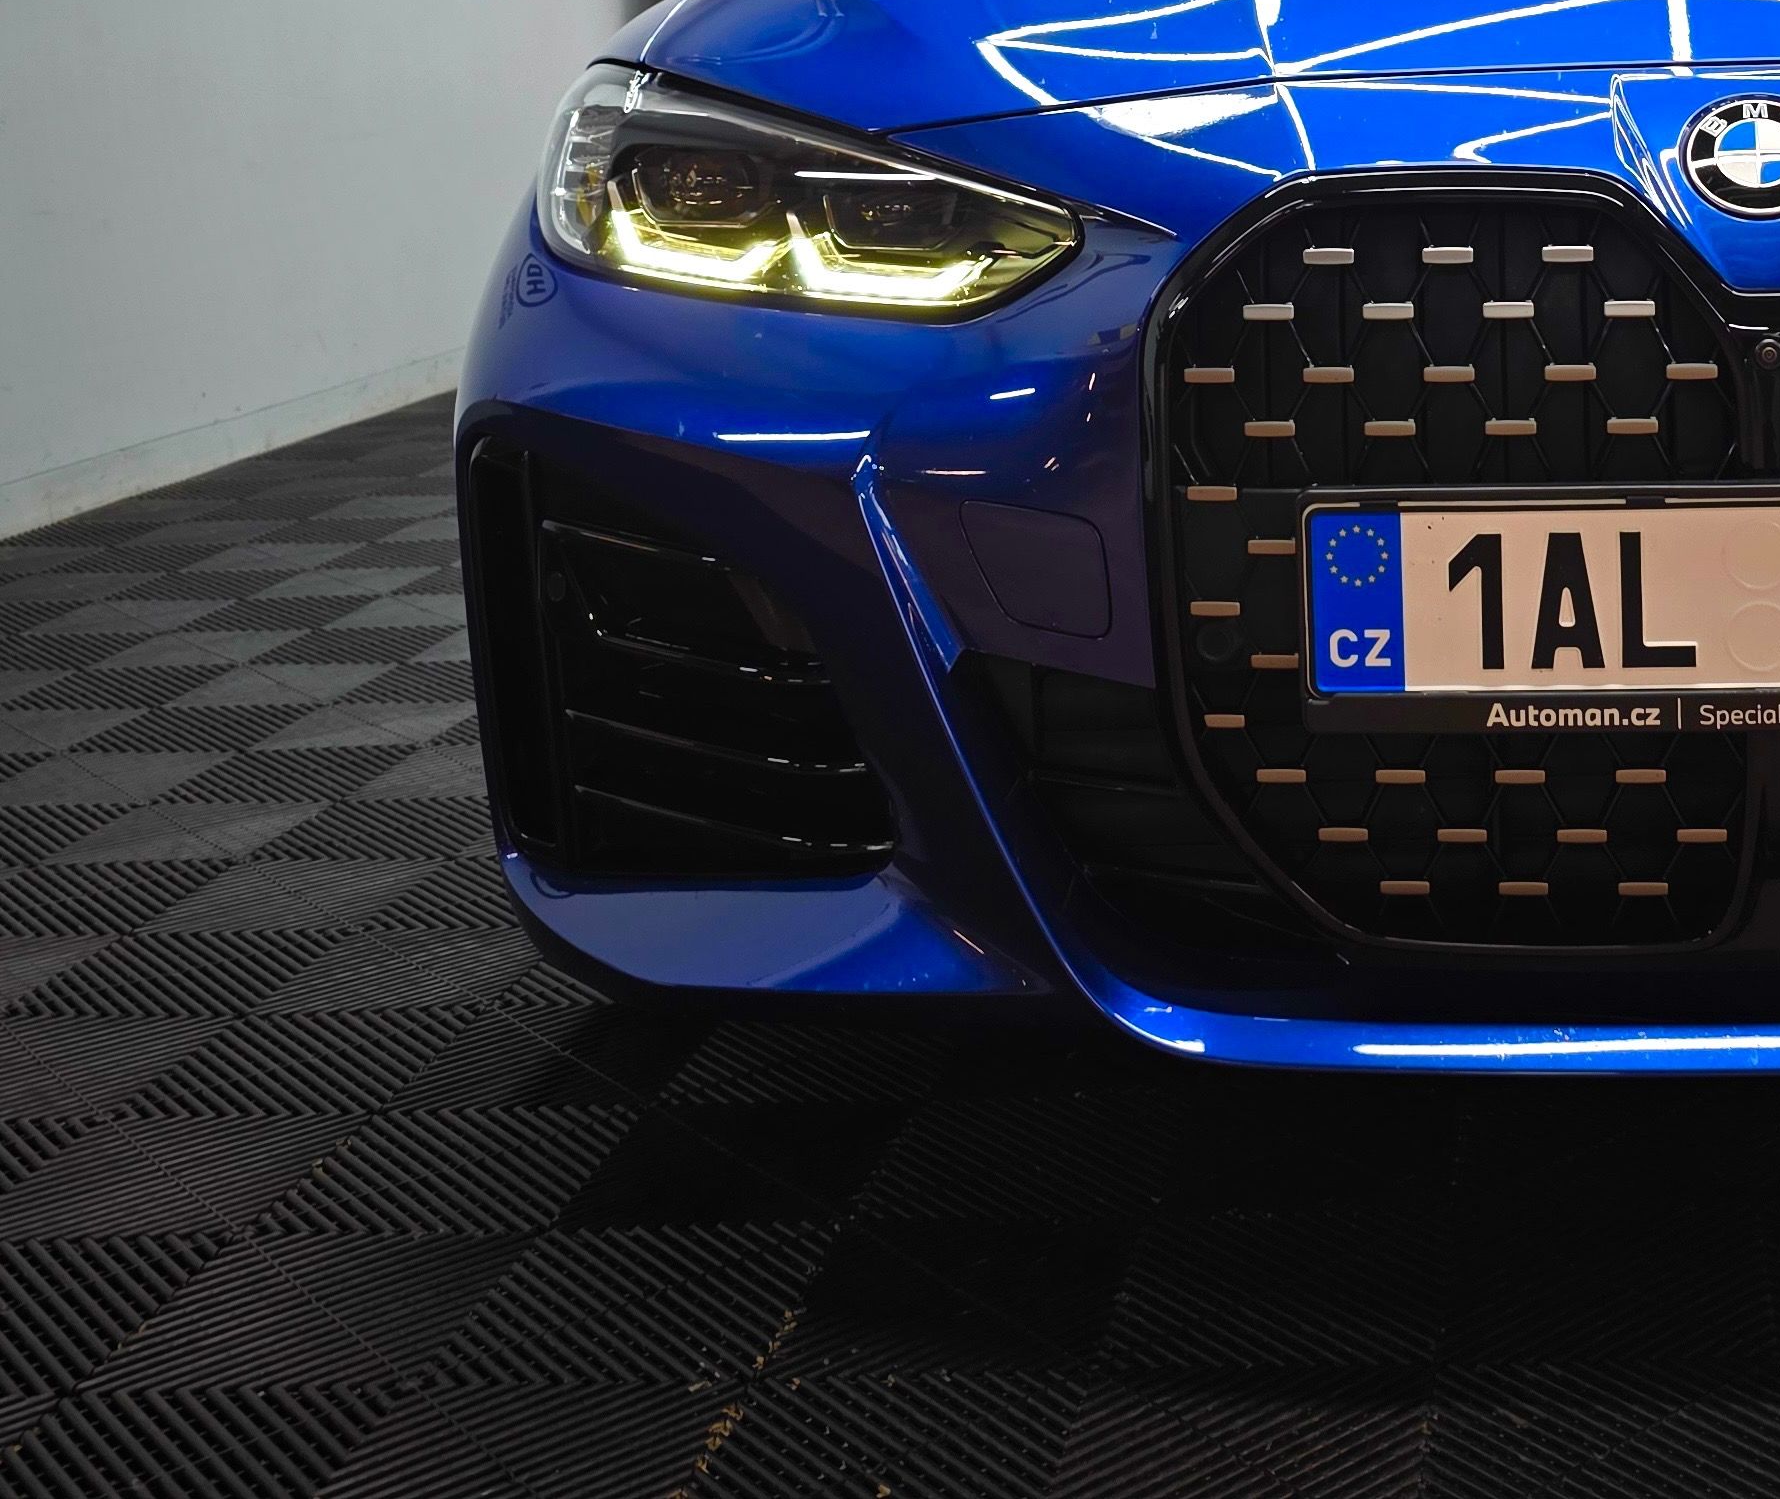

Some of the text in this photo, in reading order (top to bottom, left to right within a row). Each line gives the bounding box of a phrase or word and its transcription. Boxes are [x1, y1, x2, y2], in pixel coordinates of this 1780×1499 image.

[1448, 531, 1697, 670] 1AL
[1329, 628, 1392, 668] CZ
[1486, 702, 1661, 727] Automan.cz
